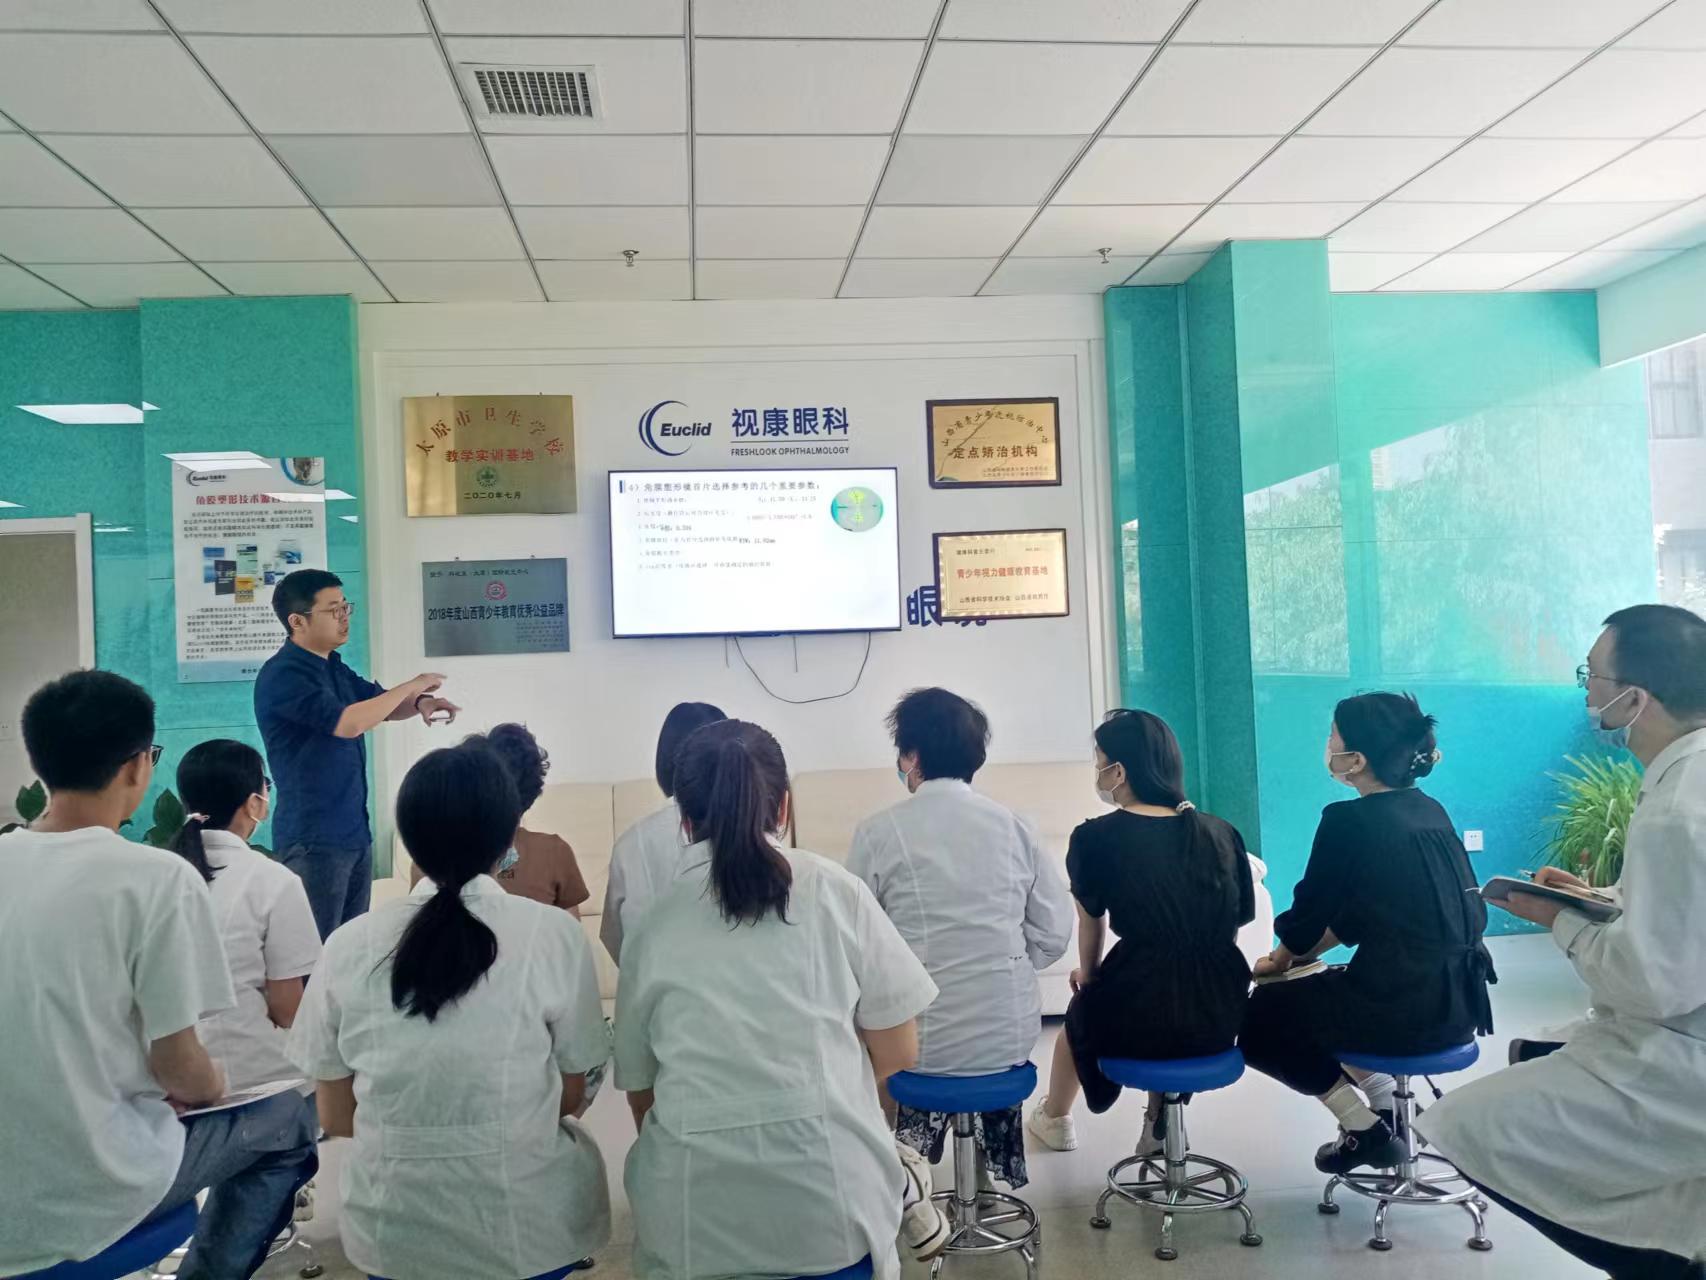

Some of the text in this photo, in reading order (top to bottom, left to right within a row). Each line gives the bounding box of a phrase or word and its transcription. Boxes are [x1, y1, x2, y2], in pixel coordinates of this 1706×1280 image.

[731, 407, 849, 437] 视康眼科
[660, 422, 712, 436] Euclid
[445, 449, 535, 462] 教学实训基地
[731, 447, 849, 456] FRESHLOOK OPHTHALMOLOGY
[952, 446, 1038, 459] 定点矫治机构
[957, 566, 1048, 579] 青少年视力健康教育基地
